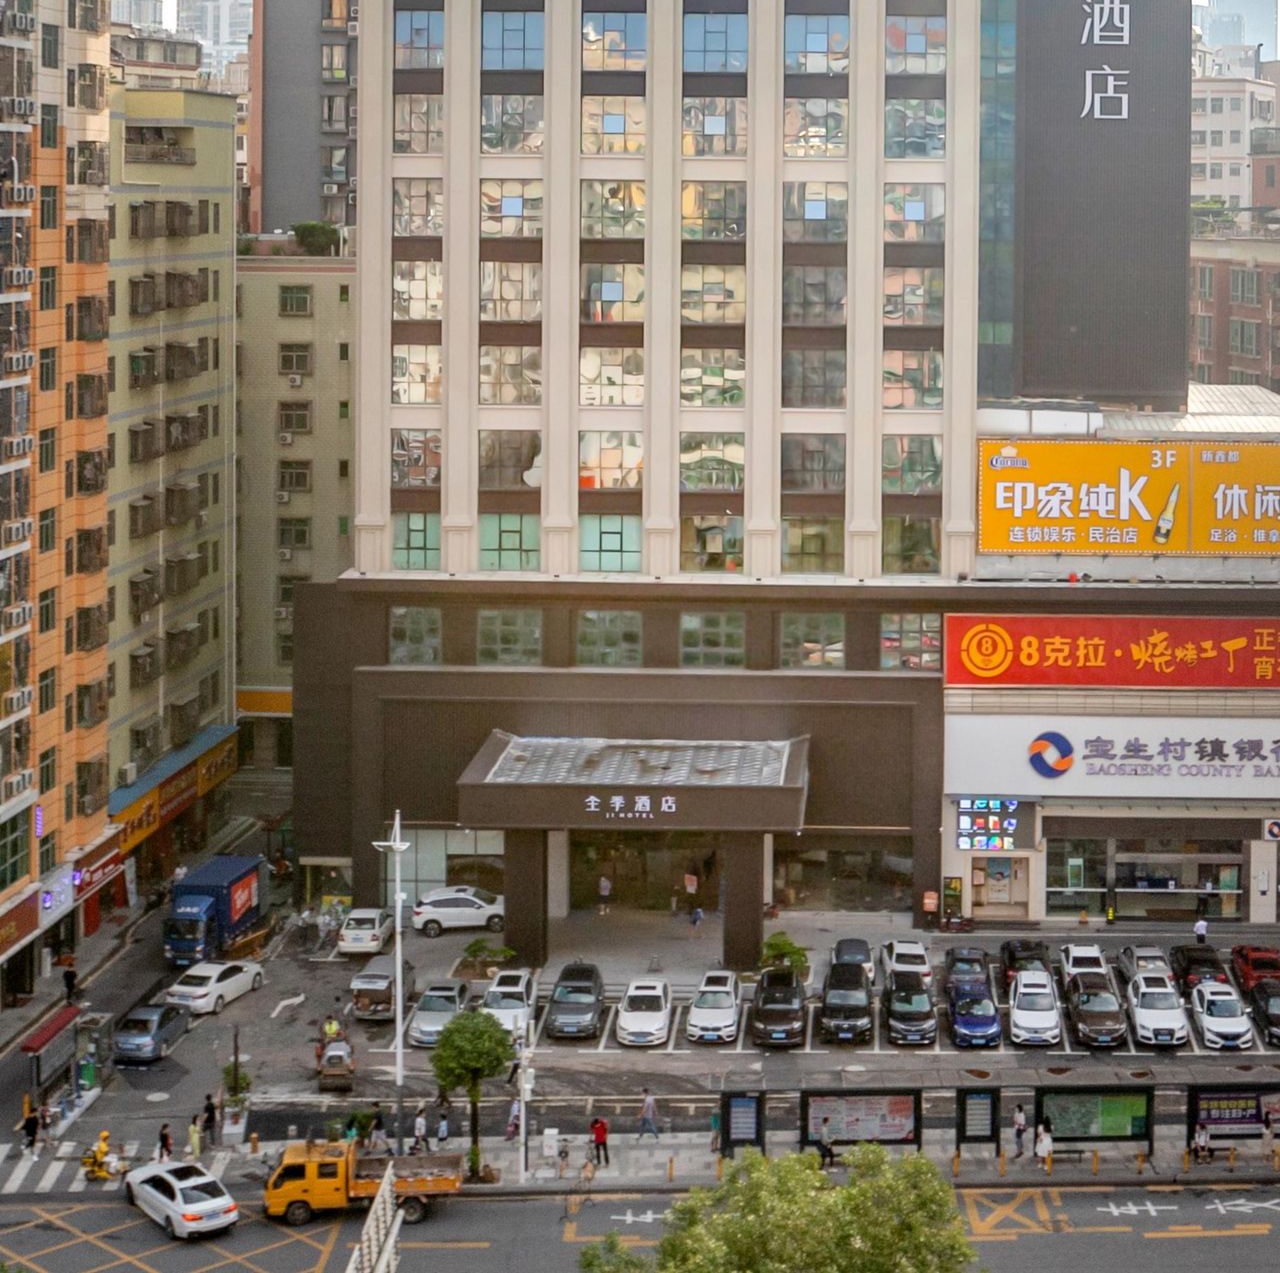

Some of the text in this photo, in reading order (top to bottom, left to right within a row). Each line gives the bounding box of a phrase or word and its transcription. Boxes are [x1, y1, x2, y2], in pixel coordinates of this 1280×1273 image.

[1151, 450, 1177, 468] 3F
[995, 467, 1152, 521] 印象纯K
[1086, 764, 1172, 777] BAOSHENG
[1177, 765, 1245, 777] COUNTY
[584, 795, 677, 812] 全季酒店
